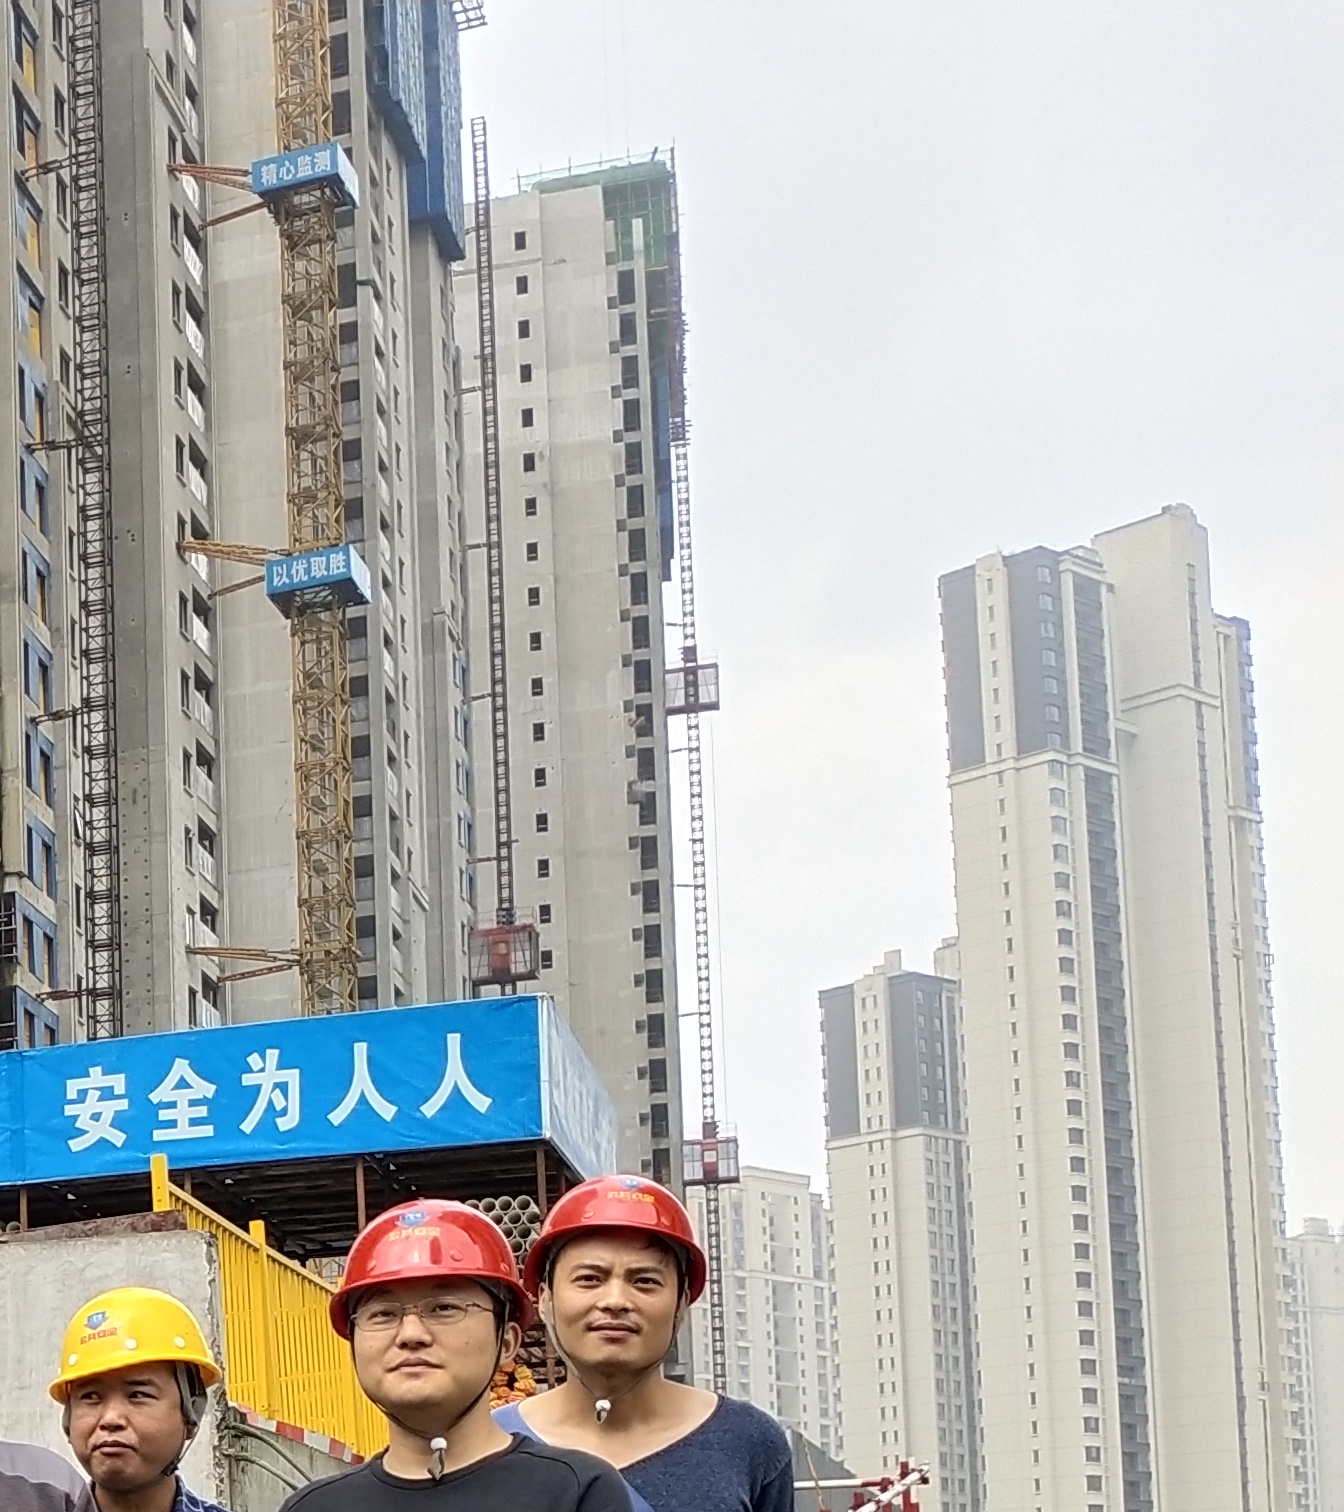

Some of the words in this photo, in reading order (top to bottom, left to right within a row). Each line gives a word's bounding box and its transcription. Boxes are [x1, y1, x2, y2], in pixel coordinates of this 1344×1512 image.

[260, 149, 330, 185] 精心监测
[272, 551, 347, 586] 以优取胜
[64, 1032, 493, 1153] 安全为人人
